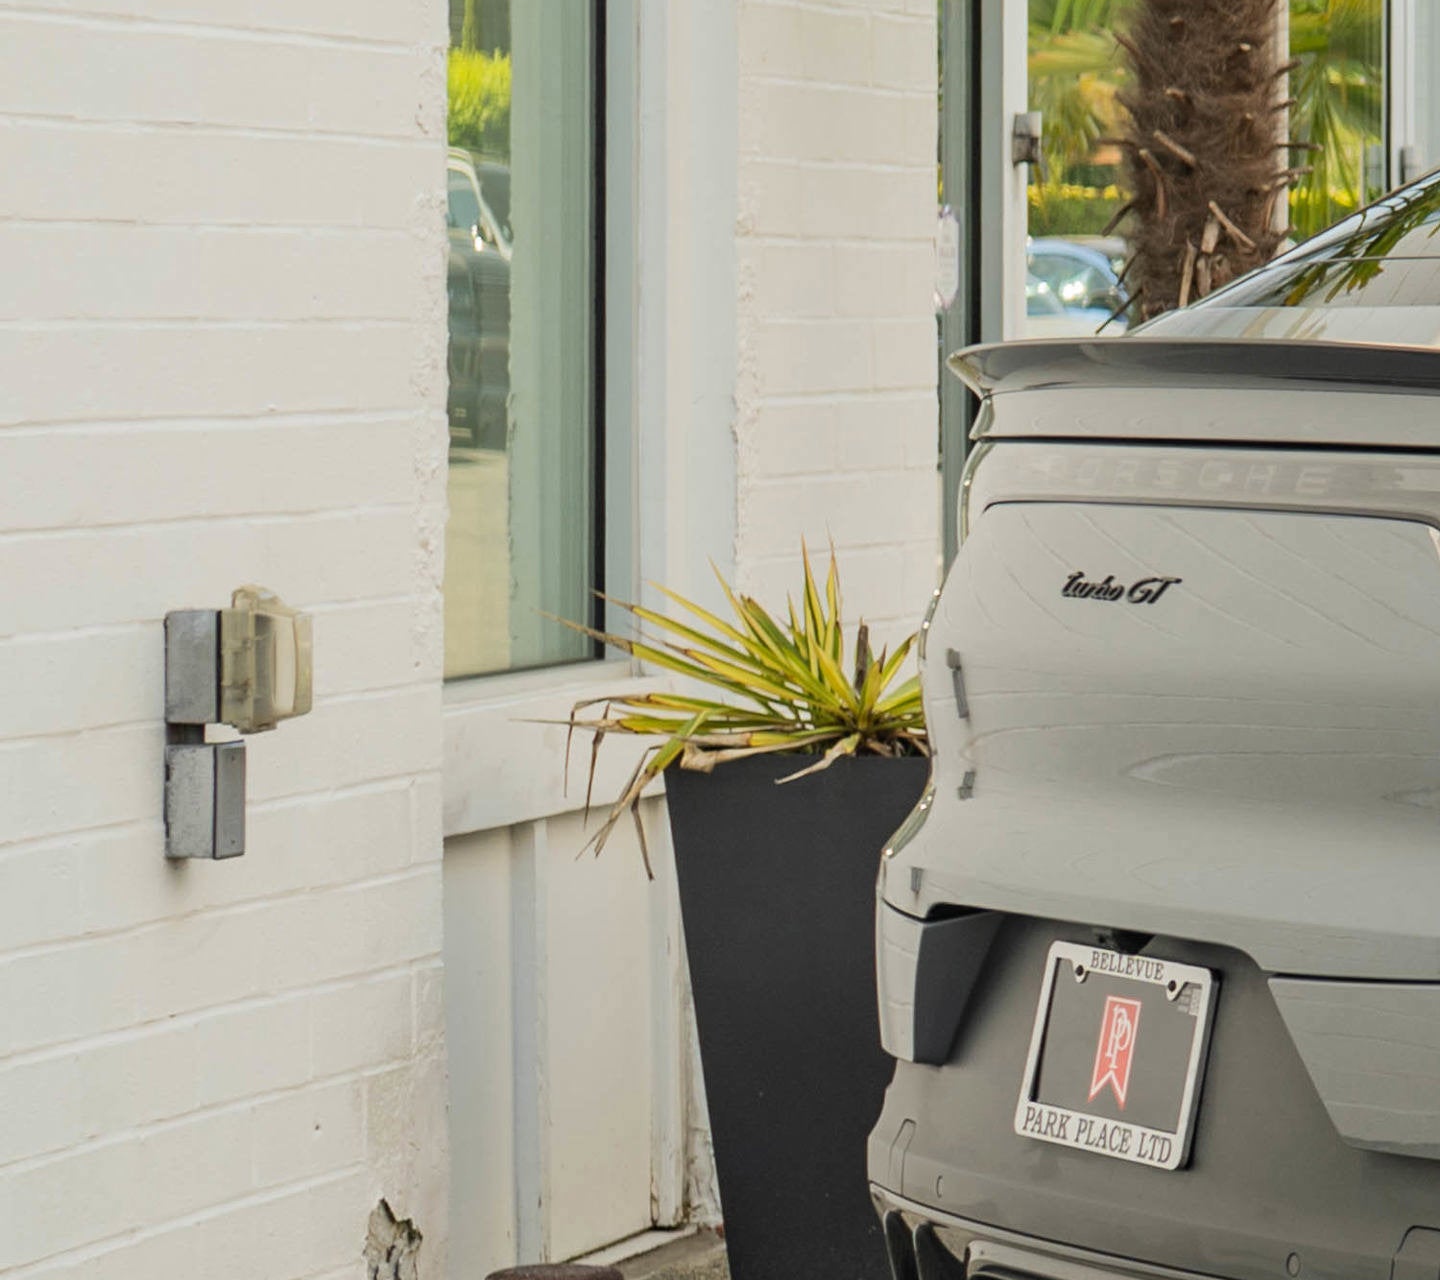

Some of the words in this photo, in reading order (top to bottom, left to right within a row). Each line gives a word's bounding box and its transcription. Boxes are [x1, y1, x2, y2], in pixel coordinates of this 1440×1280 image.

[1126, 577, 1182, 604] GT
[1090, 950, 1164, 981] BELLEVUE
[1022, 1106, 1071, 1141] PARK
[1074, 1118, 1132, 1154] PLACE
[1137, 1133, 1172, 1164] LTD
